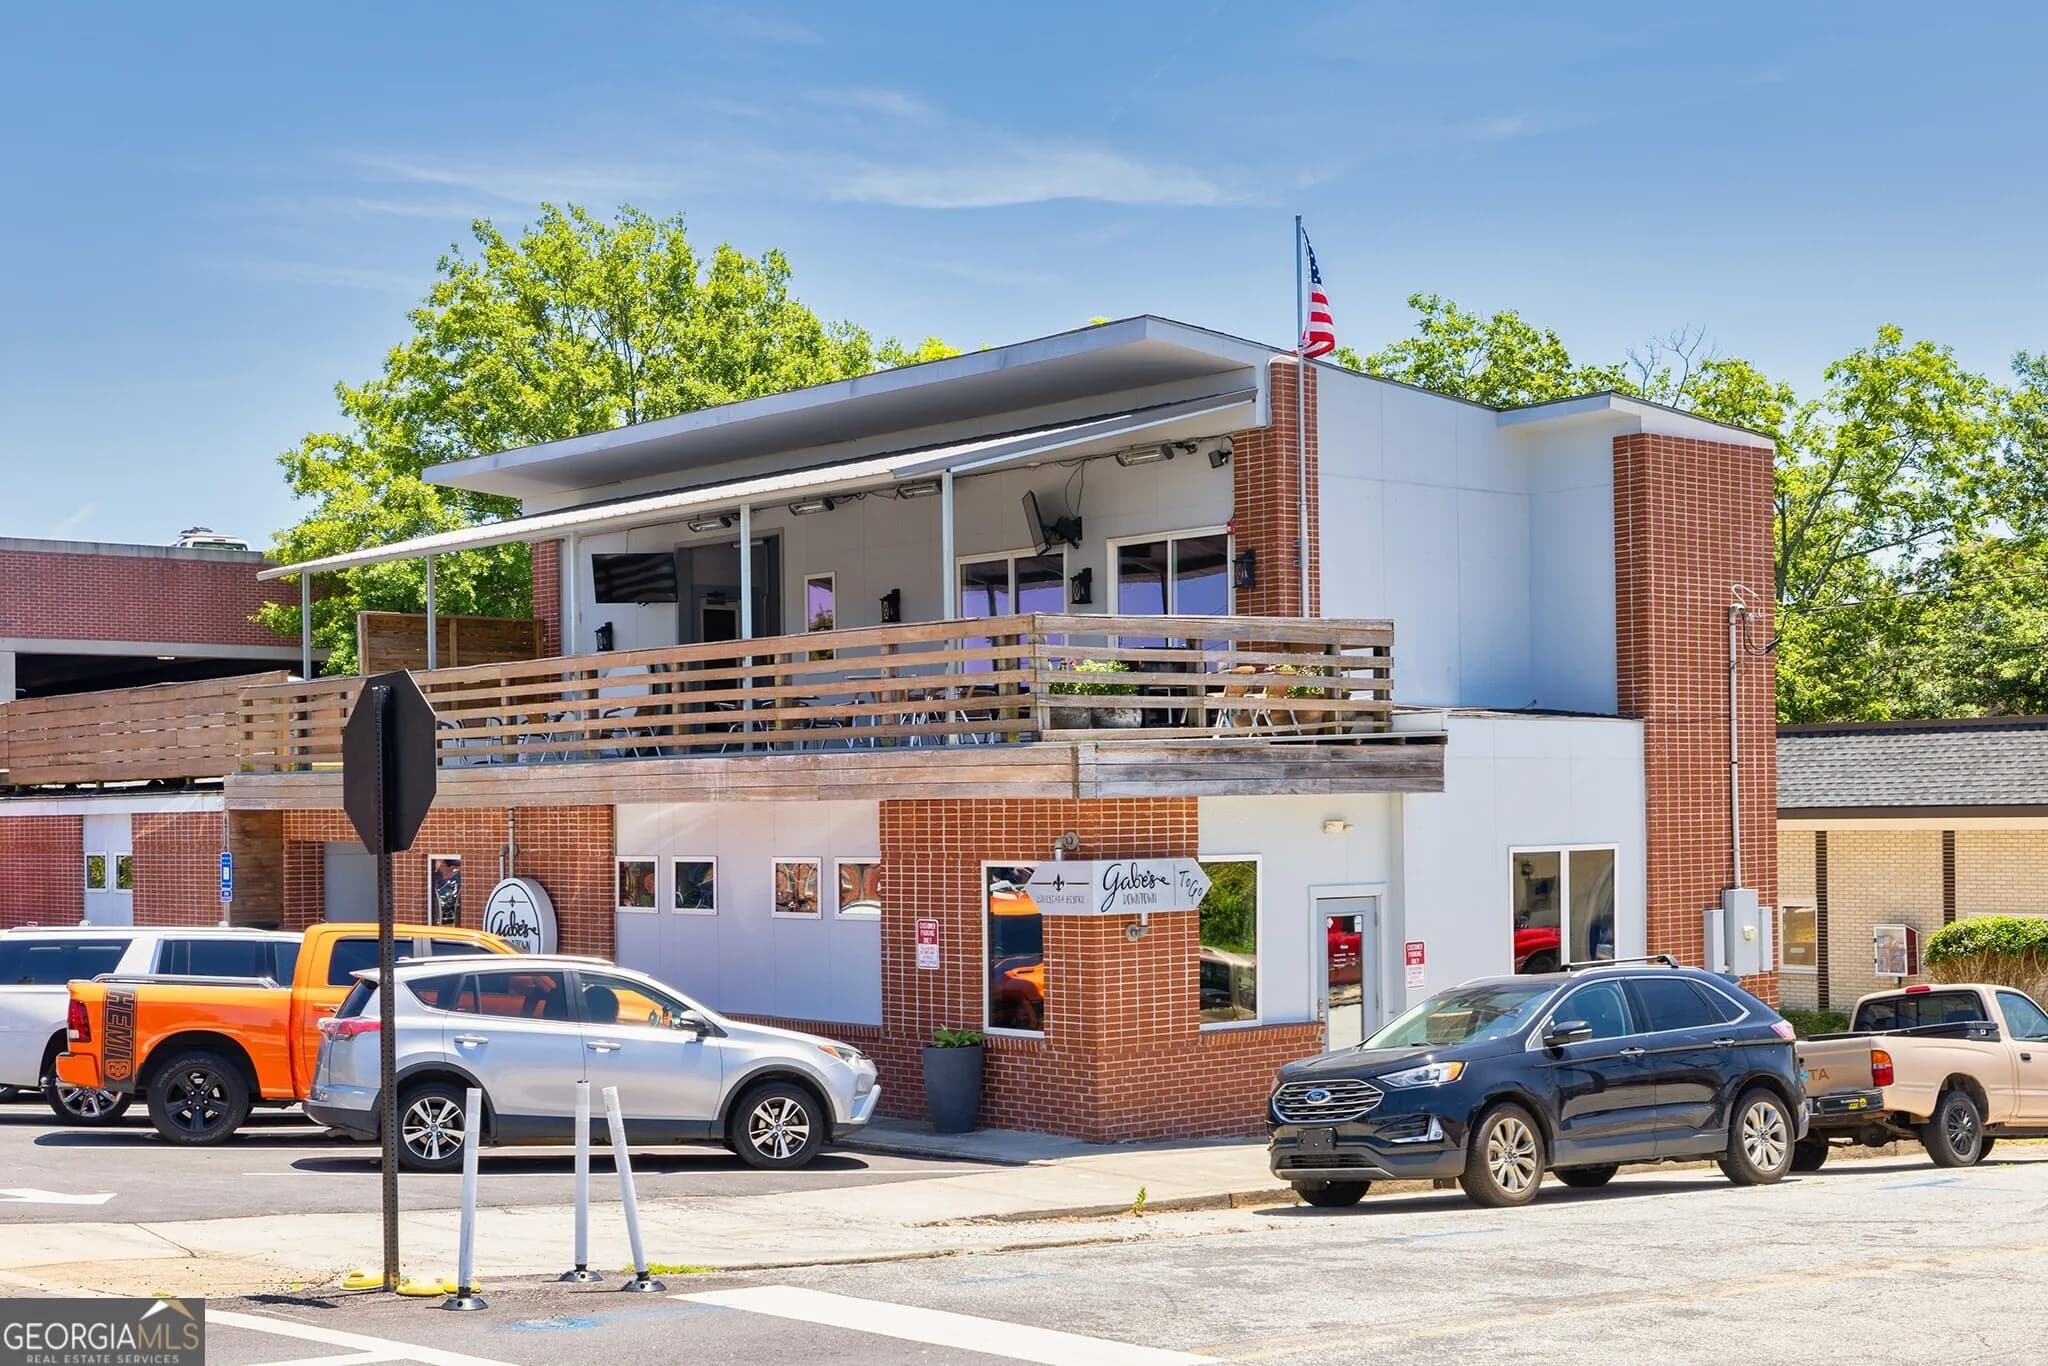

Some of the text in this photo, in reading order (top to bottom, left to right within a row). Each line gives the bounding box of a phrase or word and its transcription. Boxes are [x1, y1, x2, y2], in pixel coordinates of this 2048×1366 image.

[1101, 862, 1170, 912] Gabe's
[1123, 892, 1157, 905] DOWNTOWN
[105, 989, 134, 1059] HEMI
